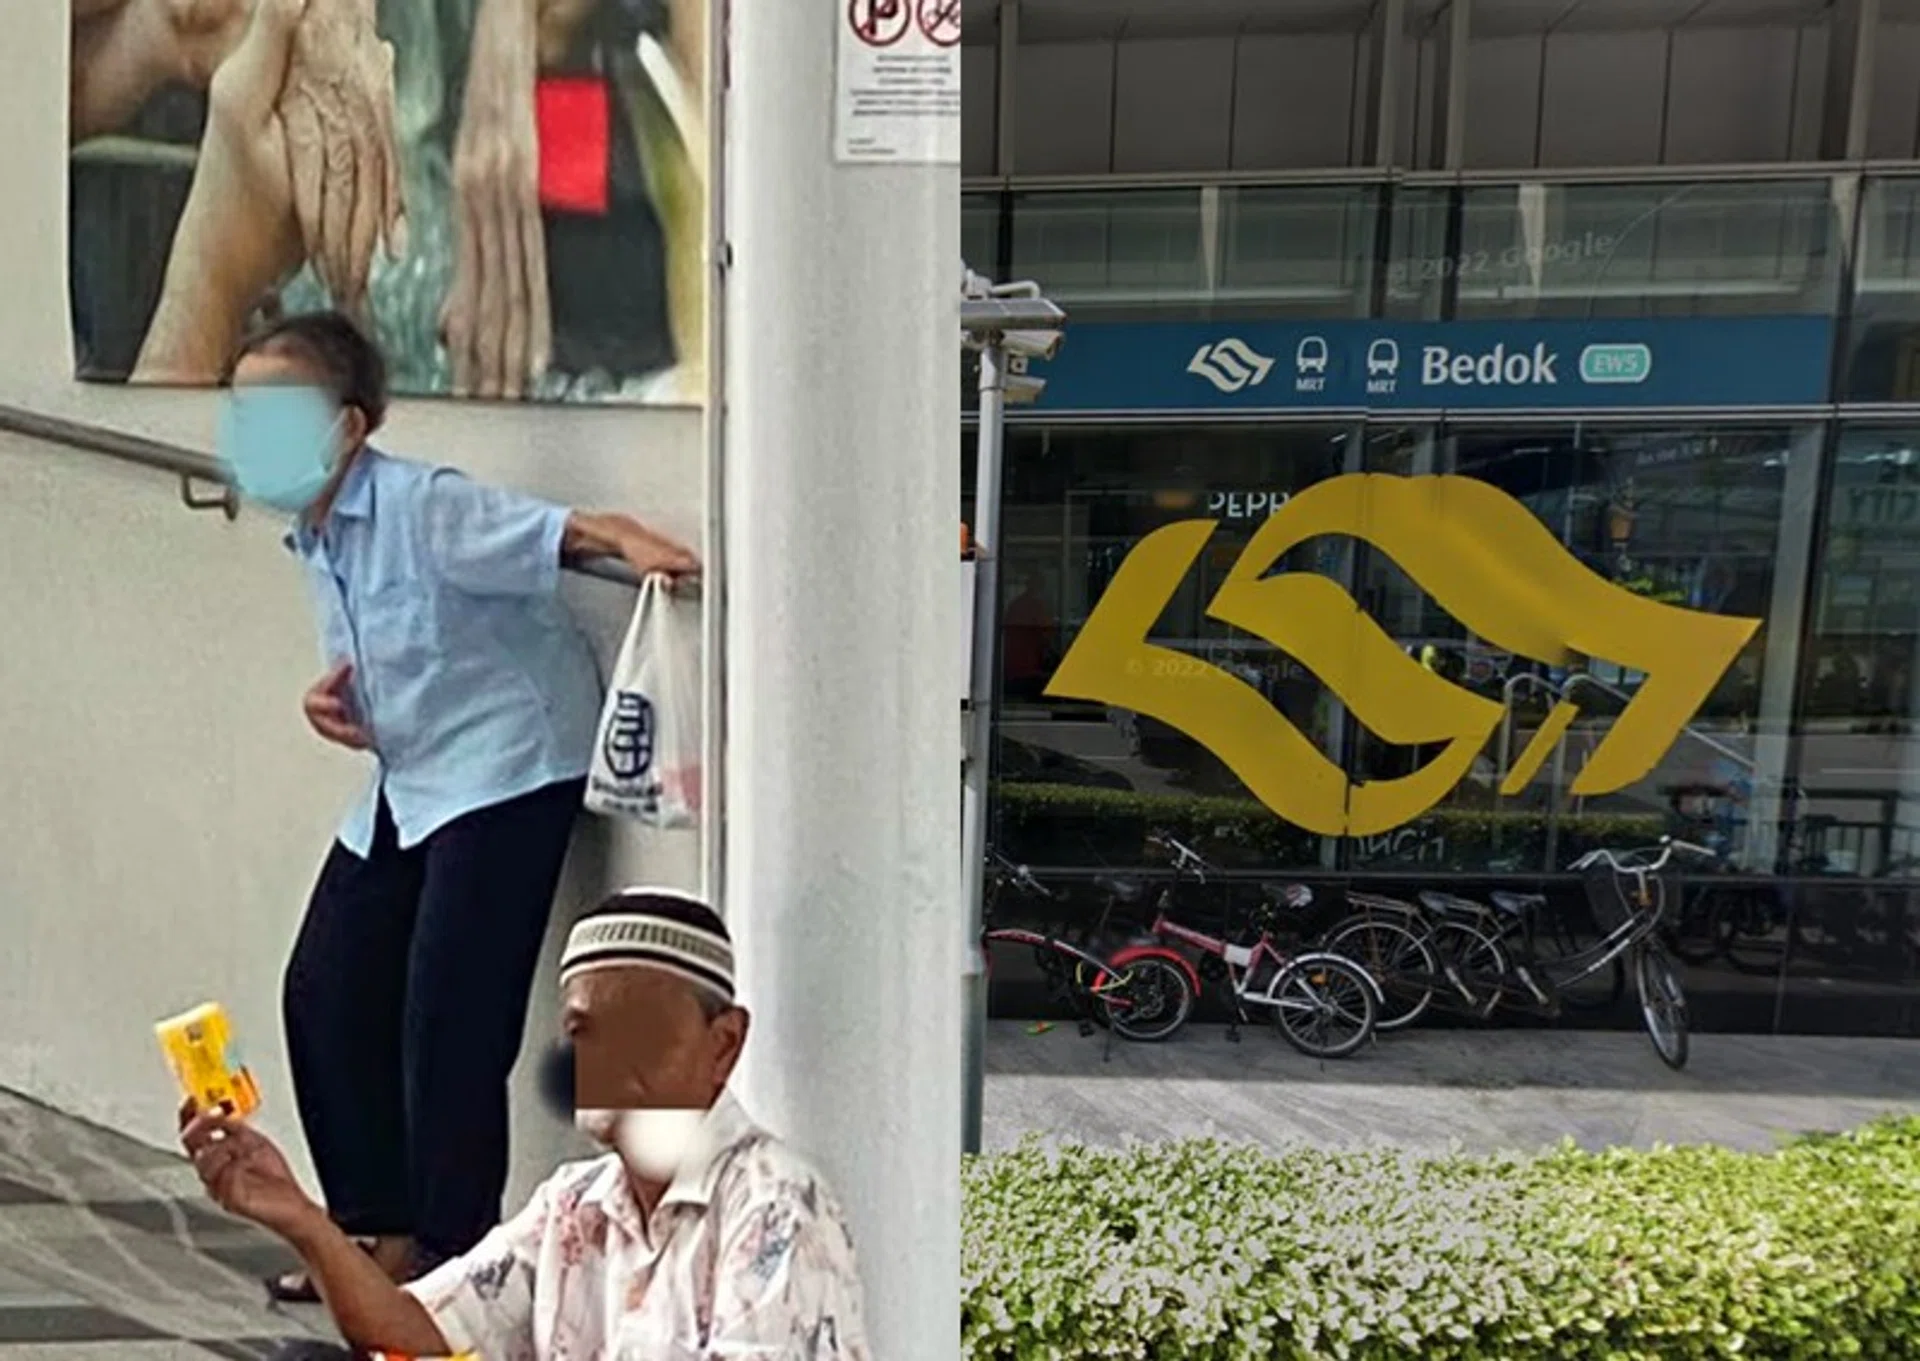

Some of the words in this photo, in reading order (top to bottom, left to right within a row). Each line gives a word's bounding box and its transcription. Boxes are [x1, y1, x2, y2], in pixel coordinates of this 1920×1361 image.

[1421, 341, 1559, 386] Bedok
[1296, 377, 1326, 391] MRT
[1366, 379, 1397, 393] MRT
